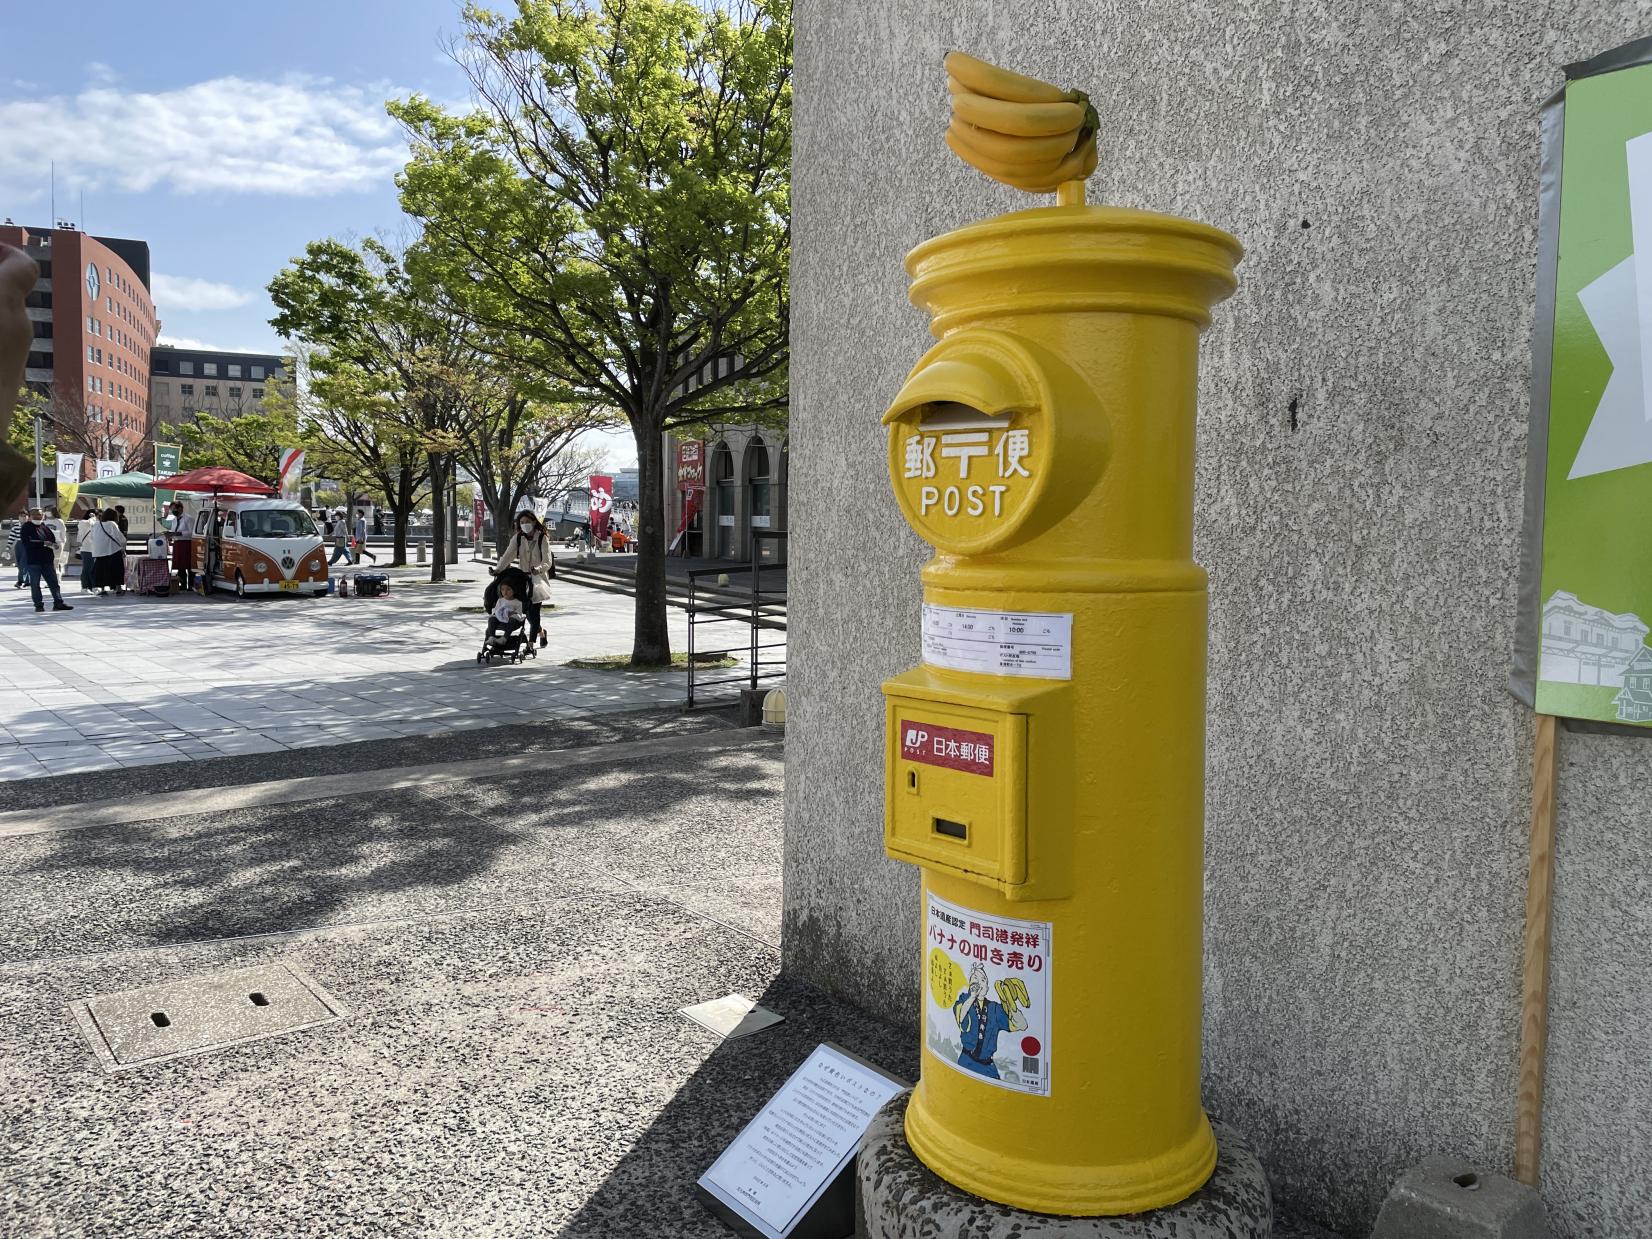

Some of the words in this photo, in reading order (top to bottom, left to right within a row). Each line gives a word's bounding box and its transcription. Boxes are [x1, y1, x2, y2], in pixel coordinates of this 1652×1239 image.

[920, 485, 1009, 517] POST
[904, 746, 927, 756] POST
[905, 729, 928, 748] JP
[933, 737, 990, 764] 日本郵便
[931, 905, 966, 930] 日本遺産認定
[969, 921, 1040, 950] 門司港発祥
[929, 924, 1044, 973] バナナの叩き売り
